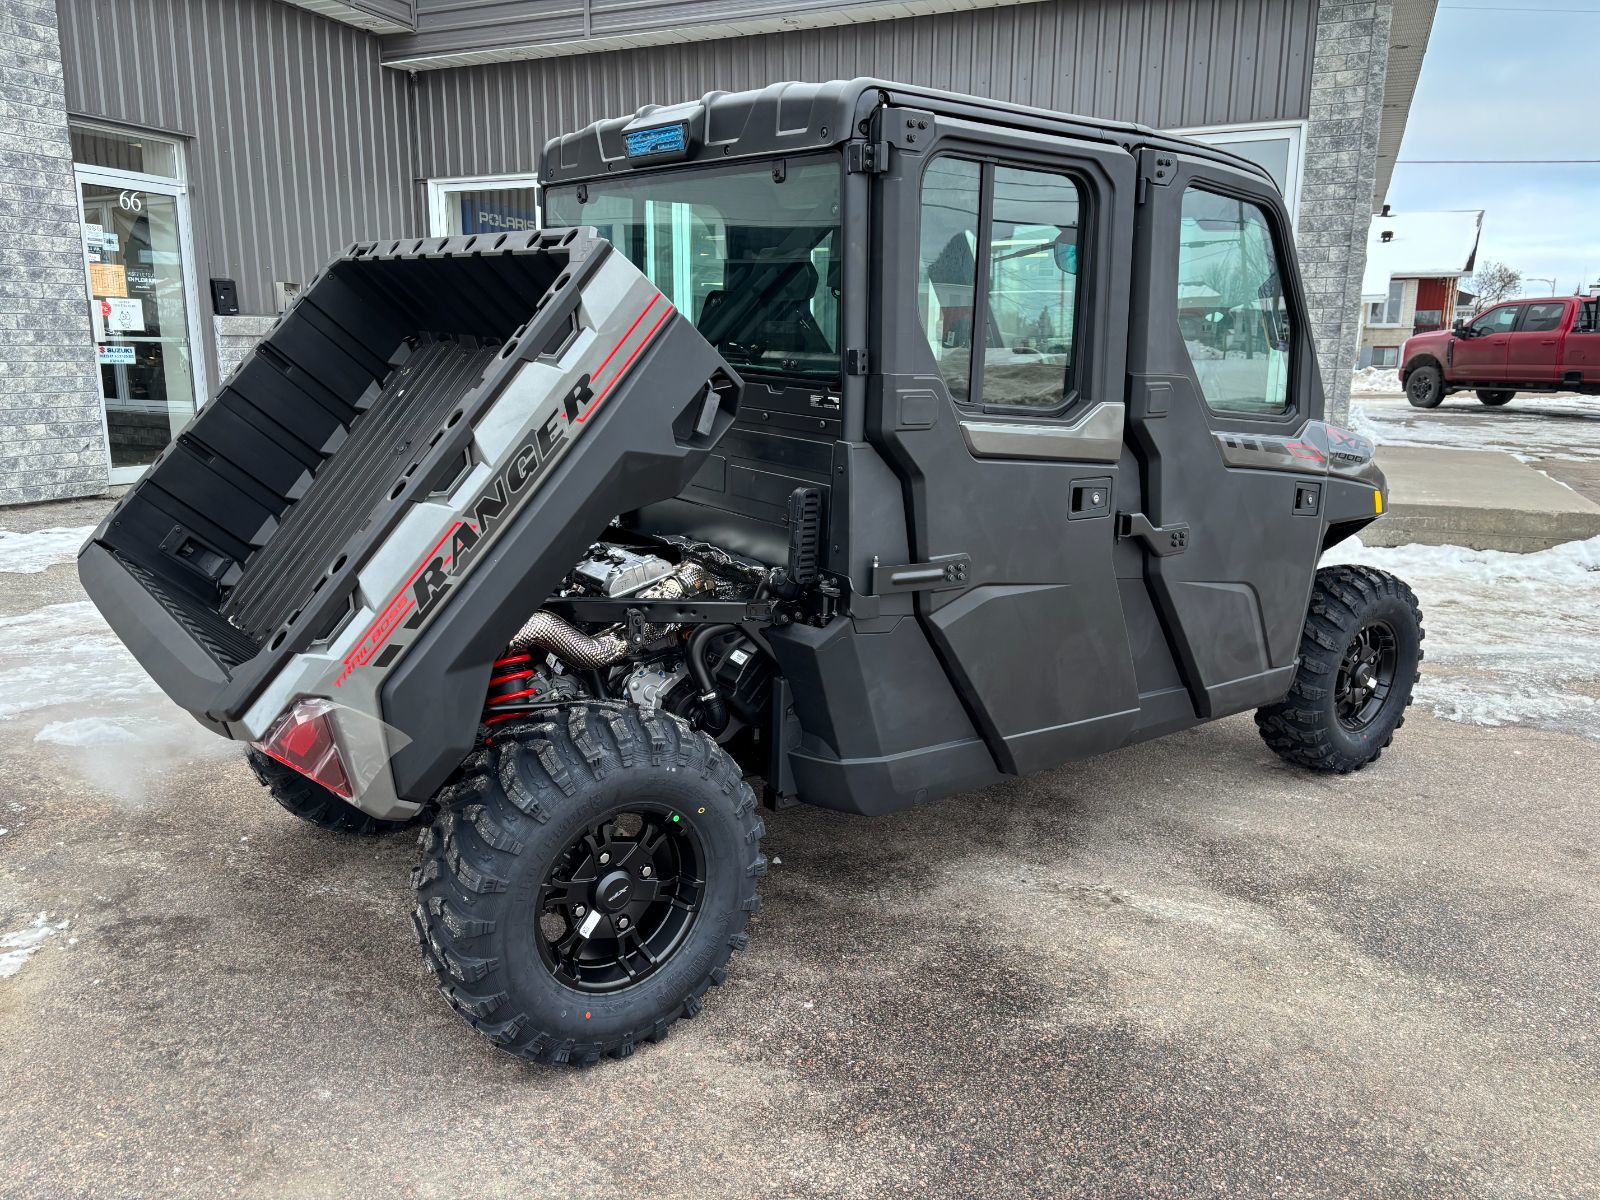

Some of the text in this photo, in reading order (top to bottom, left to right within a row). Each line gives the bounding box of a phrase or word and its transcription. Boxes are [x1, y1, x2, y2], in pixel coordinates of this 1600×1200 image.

[119, 190, 142, 212] 66
[479, 211, 536, 231] POLARIS
[1334, 452, 1363, 463] 1000
[413, 373, 595, 613] RANGER
[331, 595, 409, 689] TRAIL BOSS
